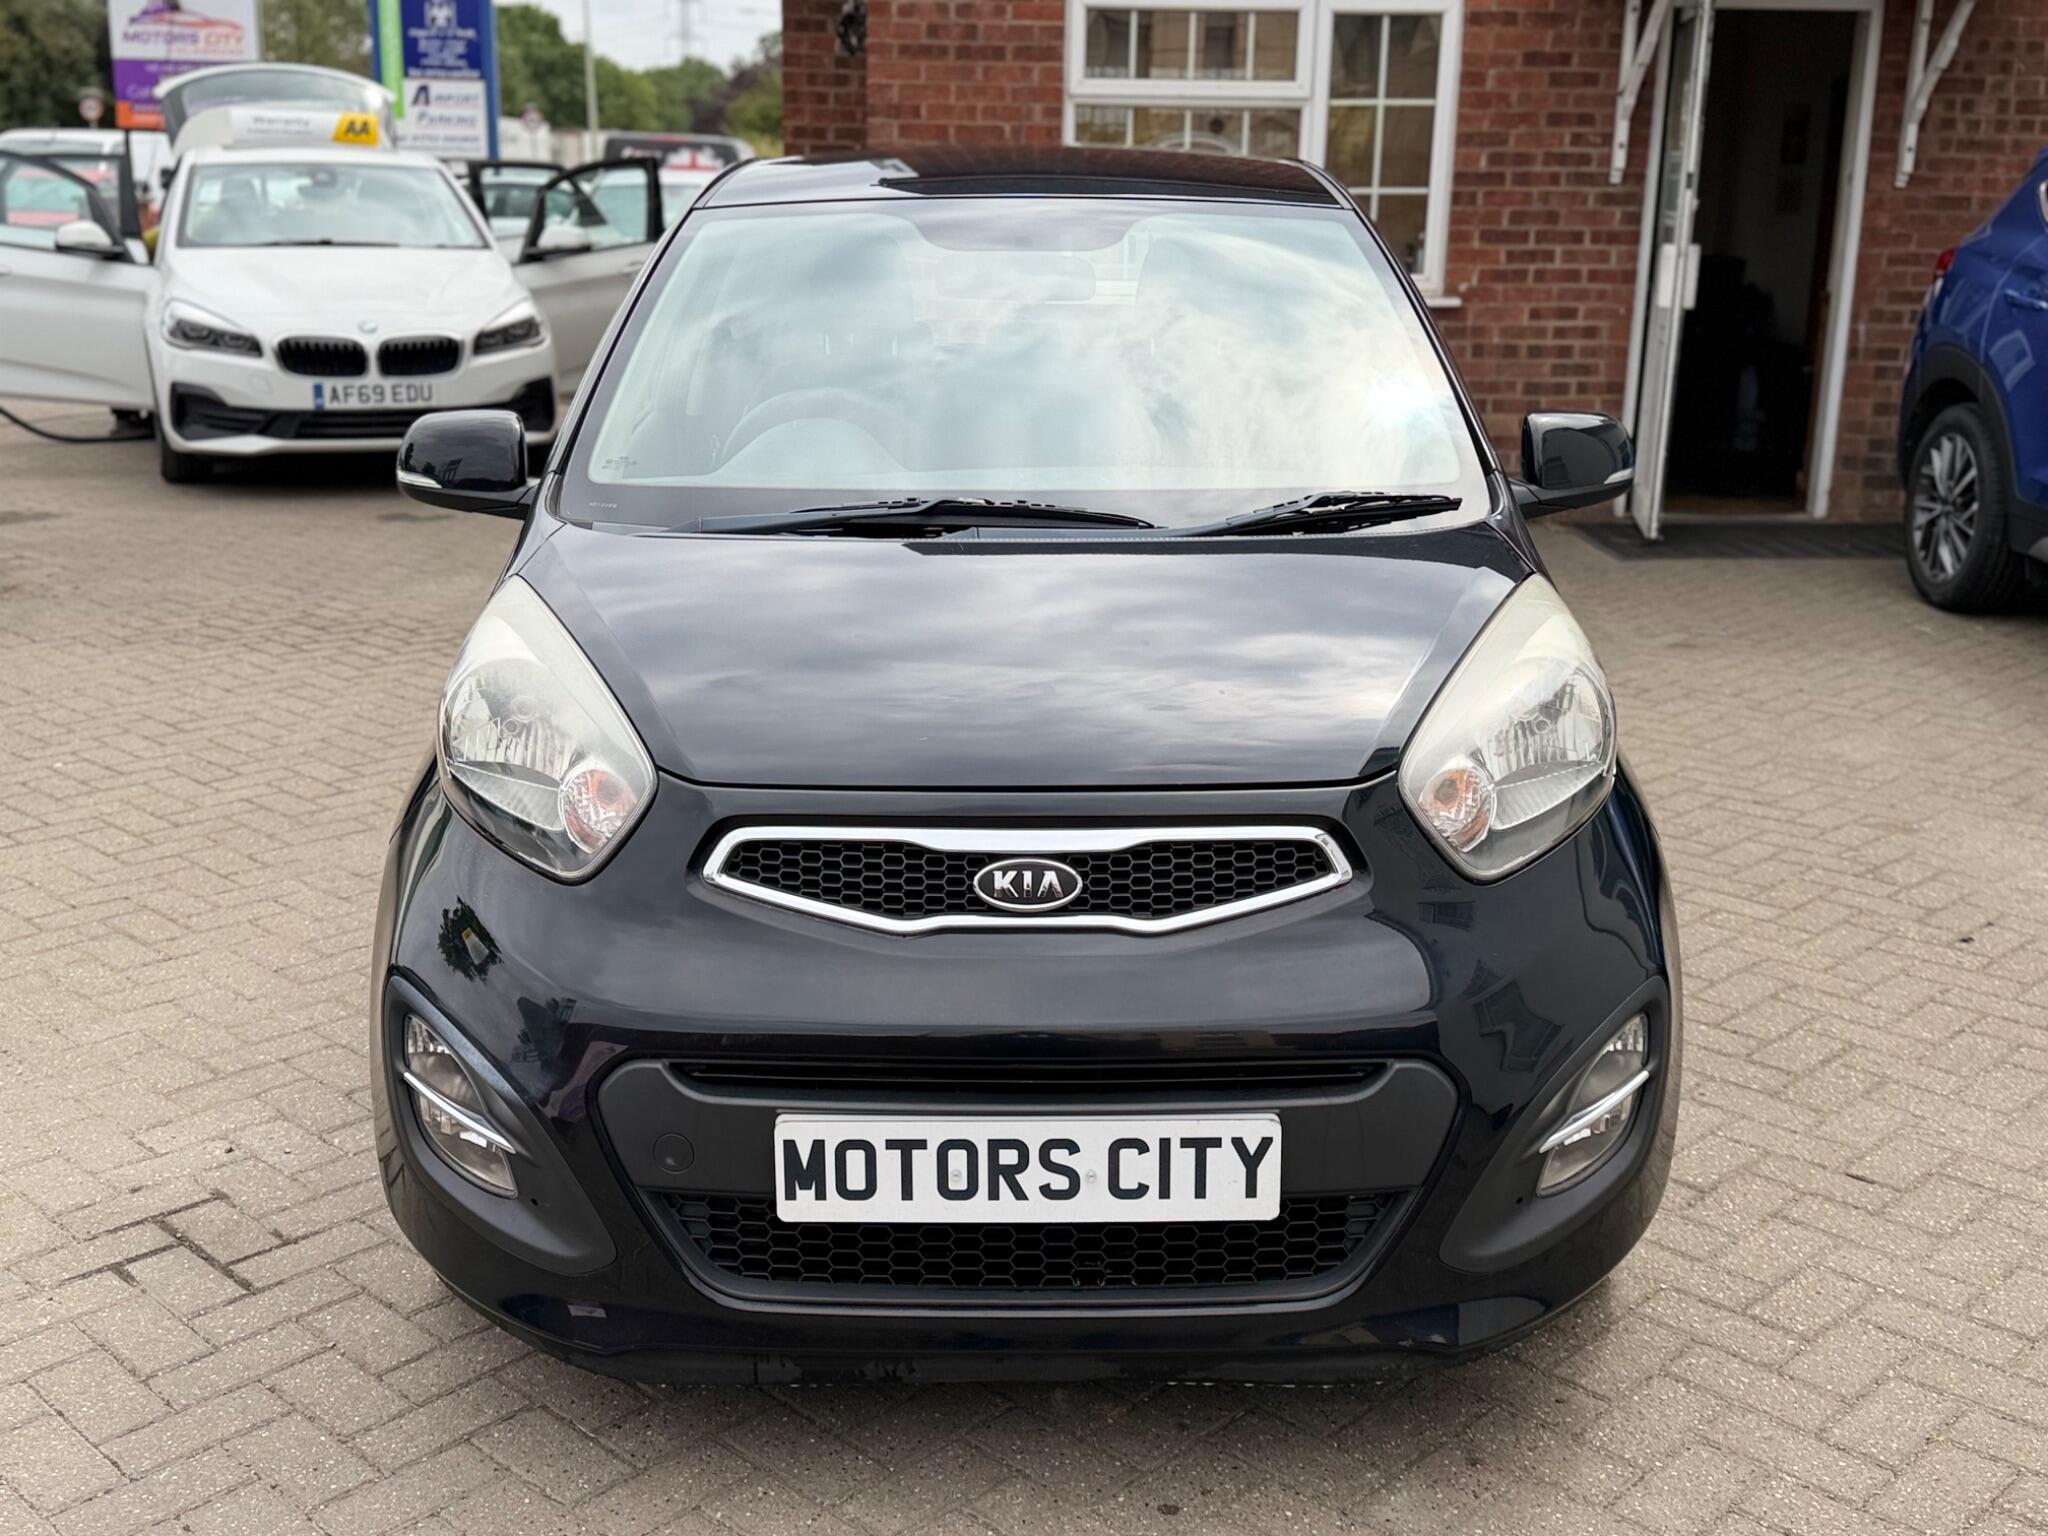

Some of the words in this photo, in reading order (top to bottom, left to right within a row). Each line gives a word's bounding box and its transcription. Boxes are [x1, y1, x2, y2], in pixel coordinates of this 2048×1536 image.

[344, 119, 371, 136] AA
[329, 384, 385, 404] AF69
[391, 383, 433, 403] EDU
[992, 870, 1064, 898] KIA
[782, 1138, 1082, 1201] MOTORS
[1107, 1136, 1275, 1200] CITY
